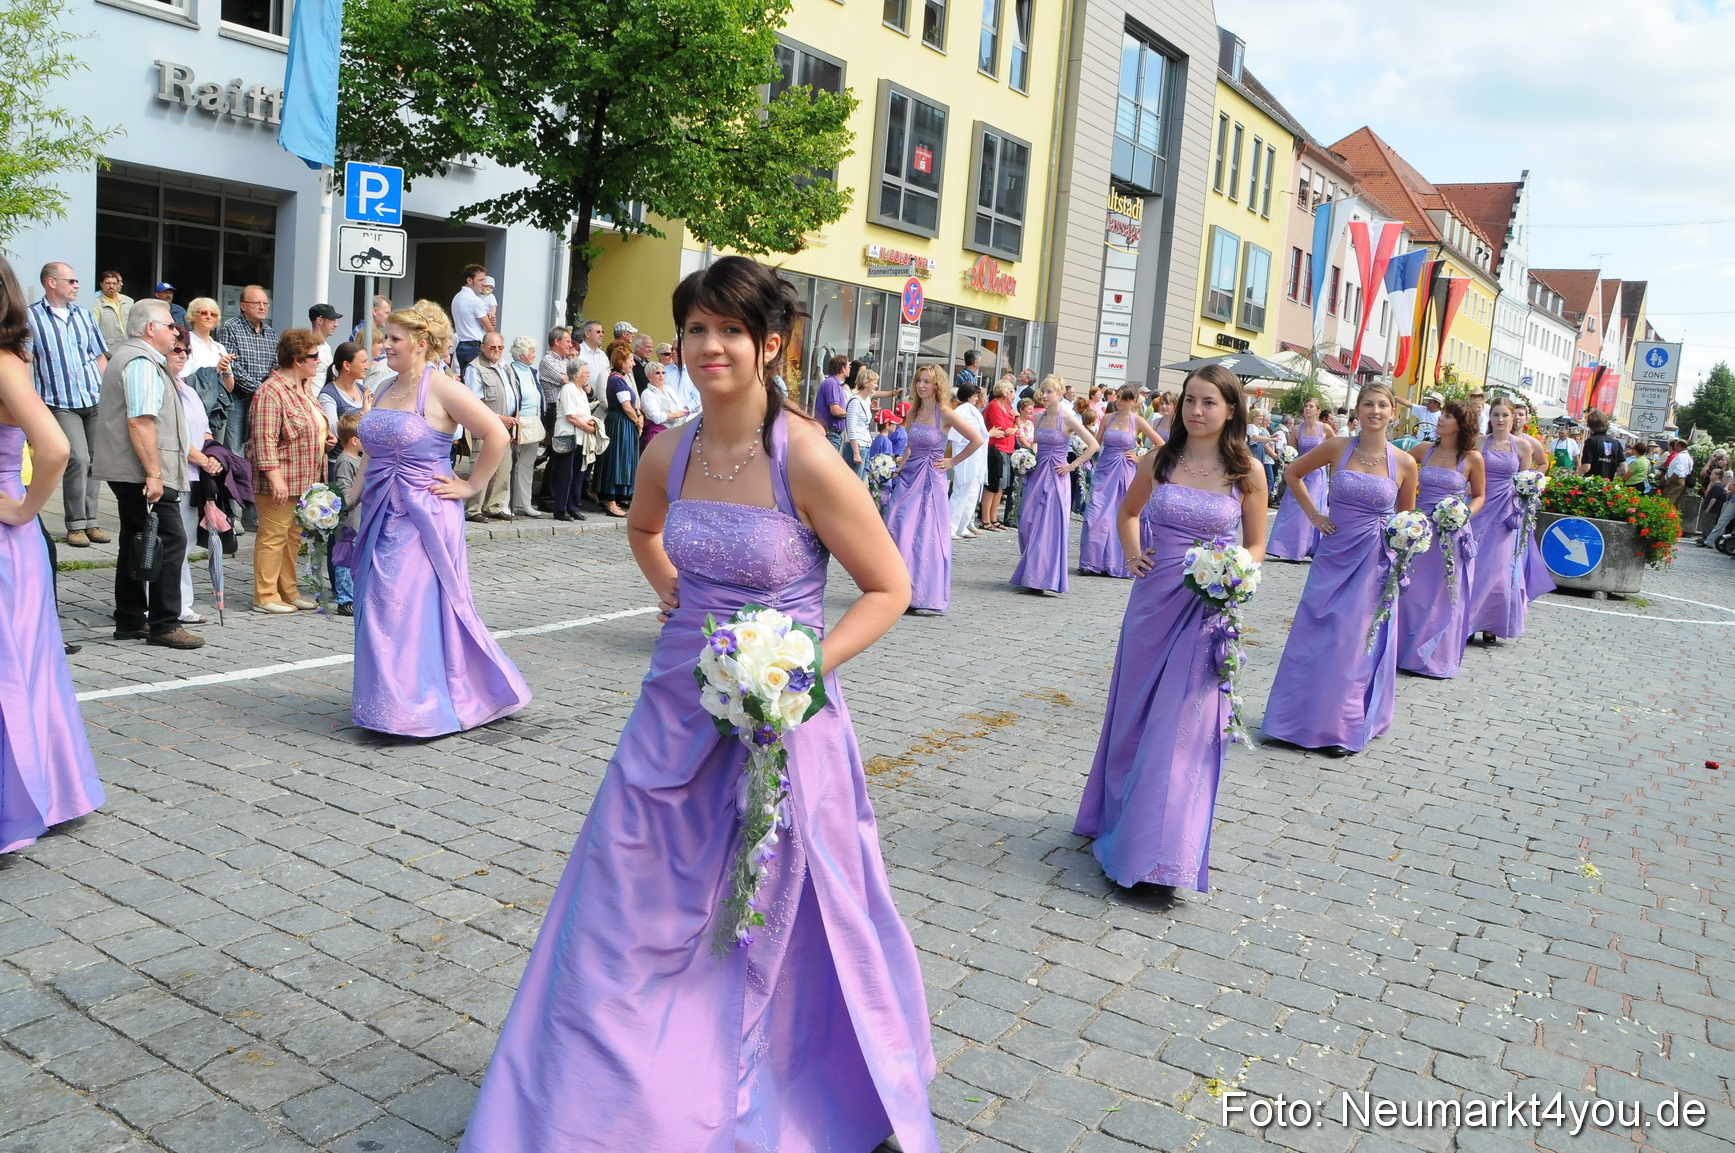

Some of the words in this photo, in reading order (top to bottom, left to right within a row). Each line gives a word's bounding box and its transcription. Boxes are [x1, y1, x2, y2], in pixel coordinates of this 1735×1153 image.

[358, 170, 390, 215] P
[868, 266, 909, 277] Brunnwirtsgasse
[1643, 371, 1666, 379] ZONE
